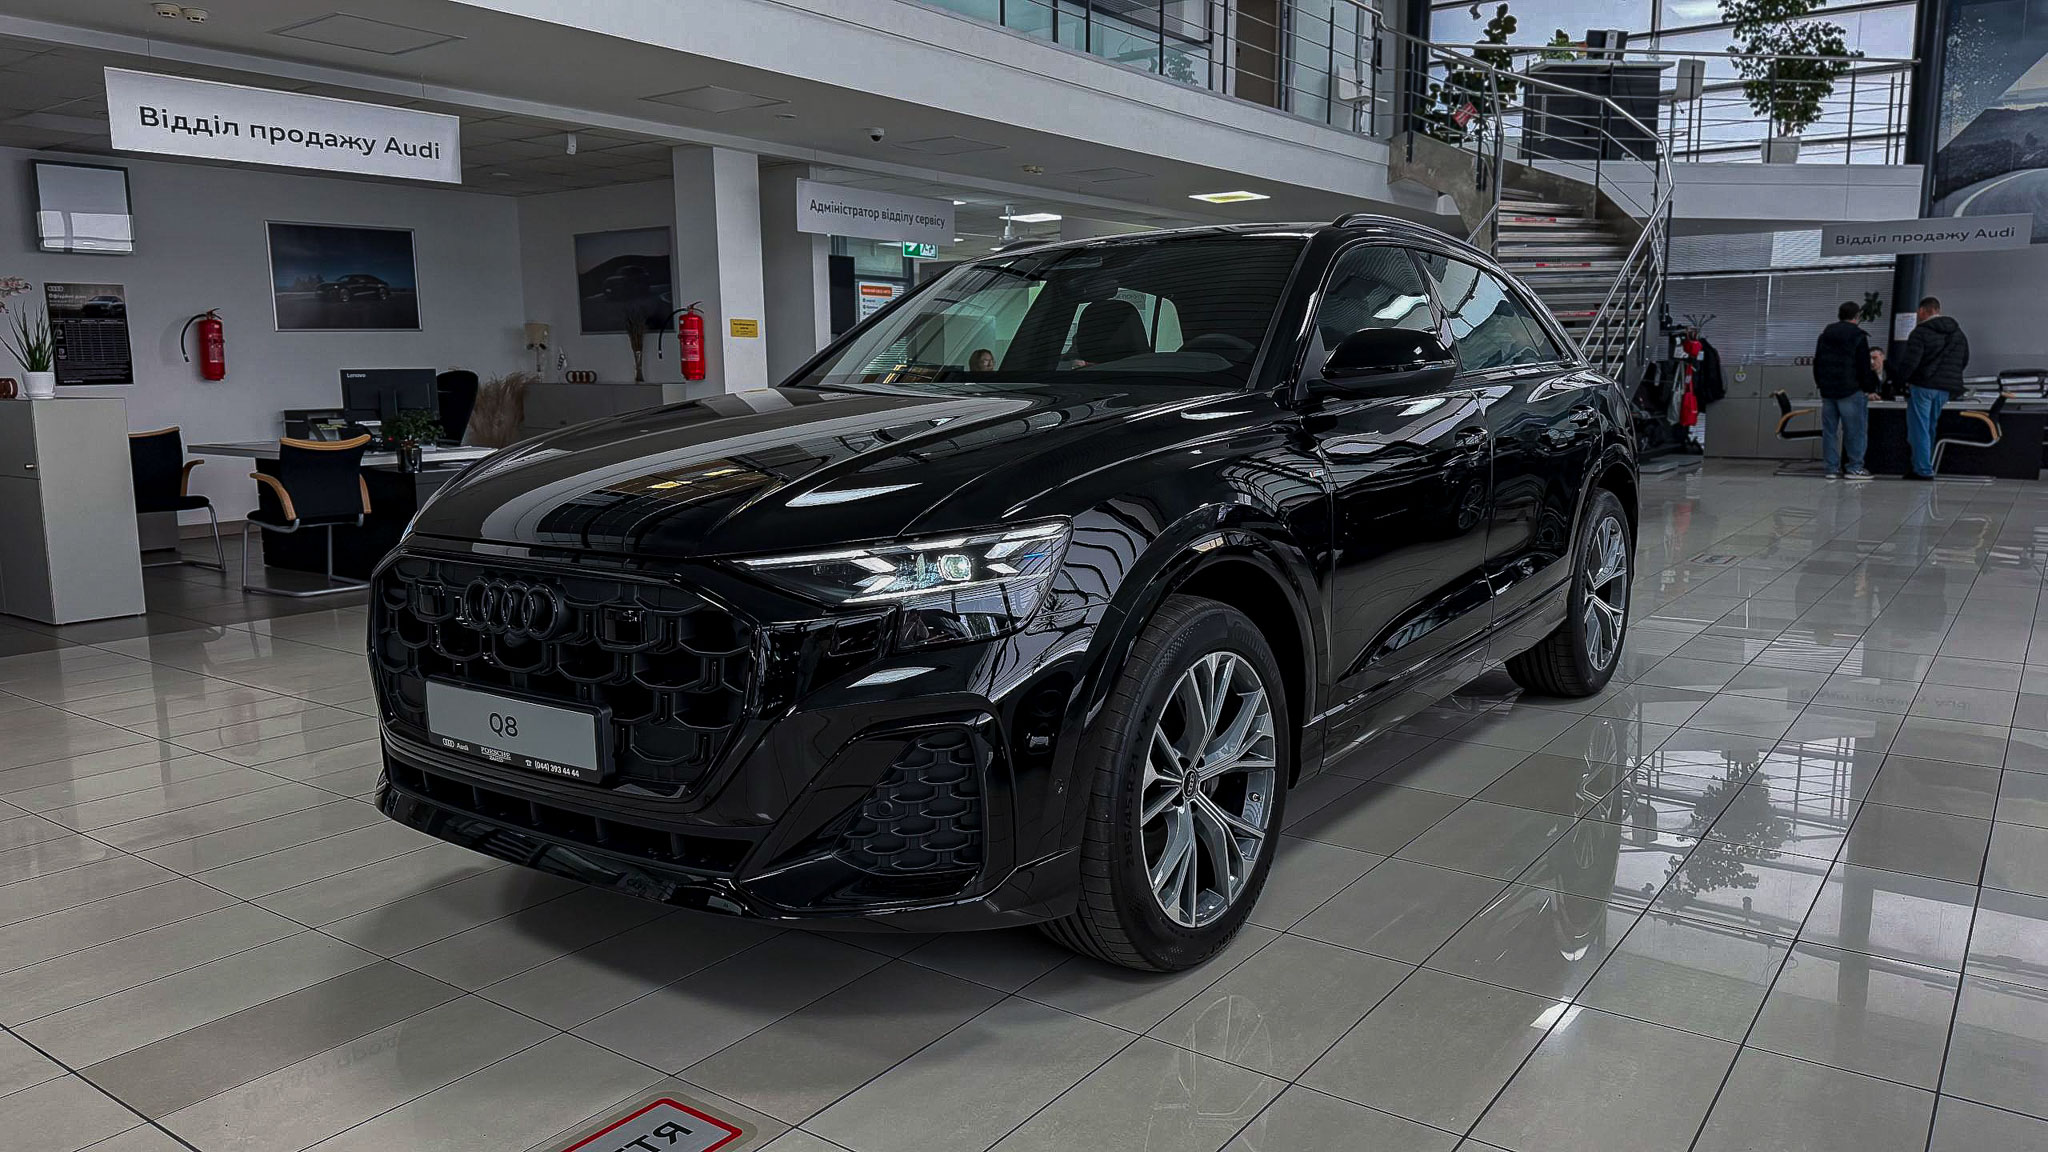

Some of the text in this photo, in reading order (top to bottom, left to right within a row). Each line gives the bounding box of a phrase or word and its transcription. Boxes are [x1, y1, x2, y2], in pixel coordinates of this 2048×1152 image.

[139, 105, 440, 160] Відділ продажу Audi
[810, 199, 946, 229] Адміністратор відділу сервісу
[1835, 227, 2016, 246] Відділ продажу Audi
[489, 712, 519, 738] Q8
[534, 760, 550, 772] (044)
[550, 764, 562, 774] 393
